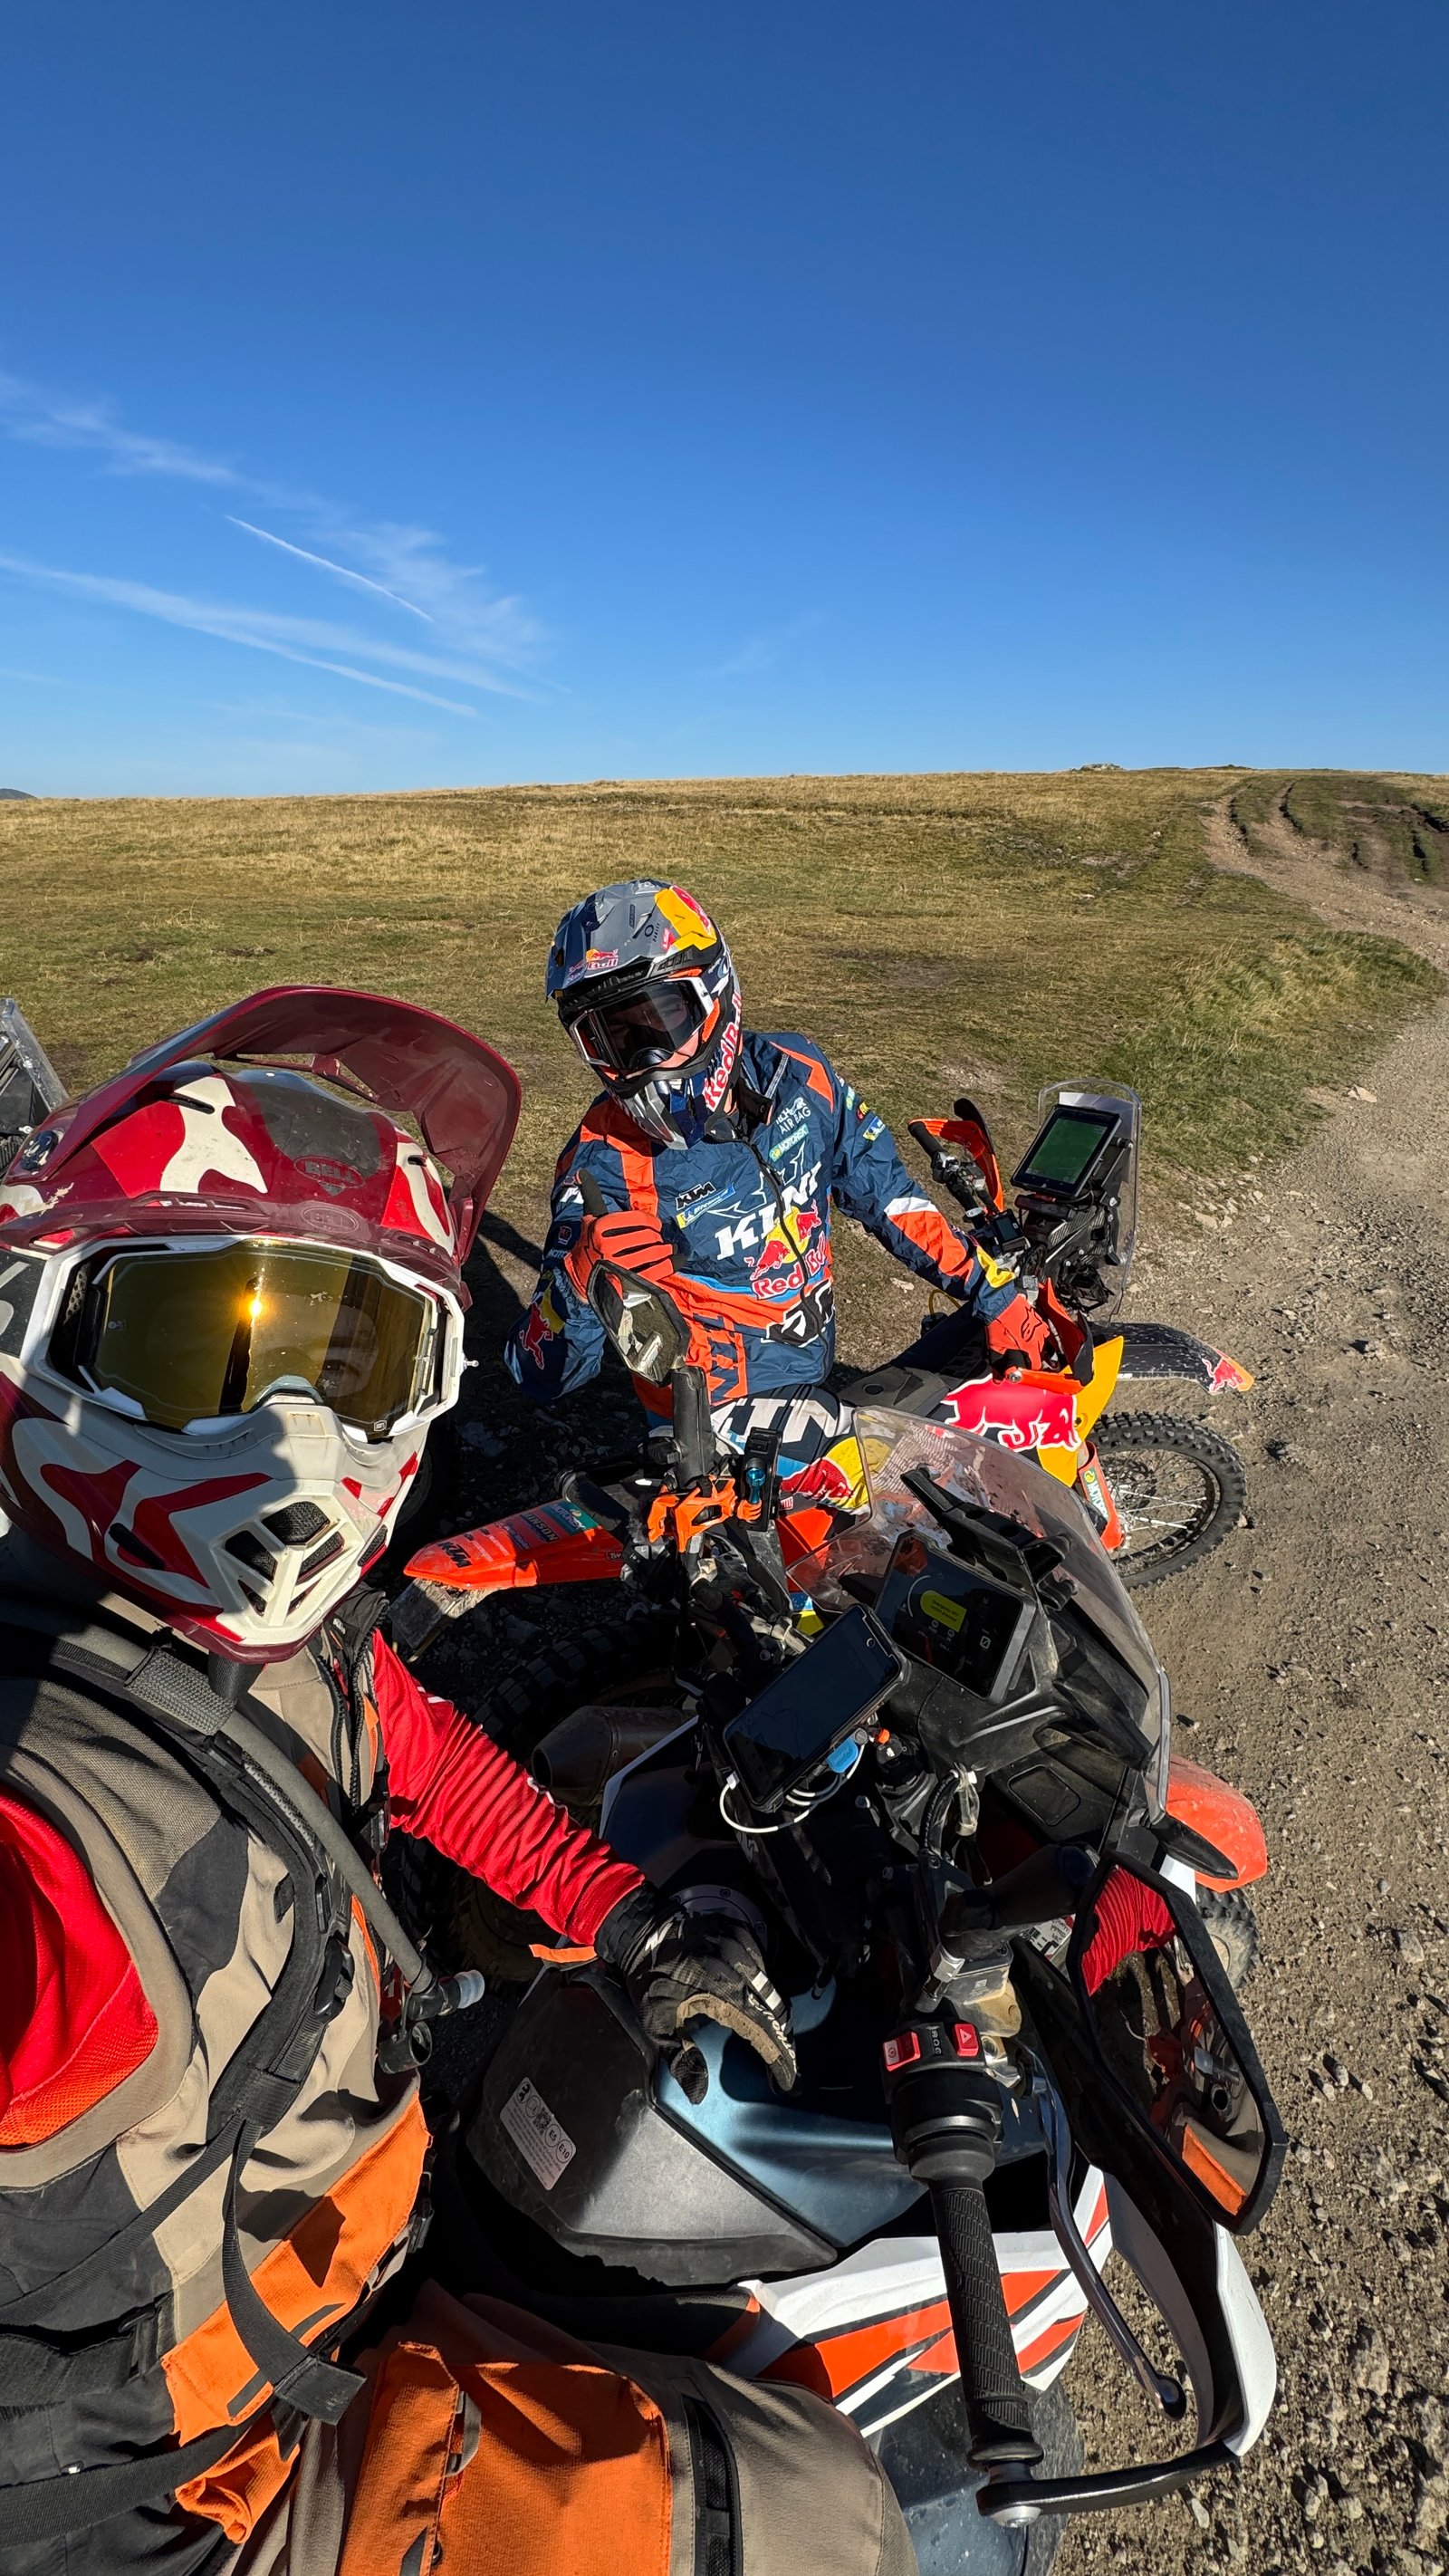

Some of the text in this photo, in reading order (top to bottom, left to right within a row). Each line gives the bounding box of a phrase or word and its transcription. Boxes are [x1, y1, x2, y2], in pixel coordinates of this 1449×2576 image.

[702, 1039, 735, 1112] Red
[304, 1160, 356, 1186] BELL
[677, 1182, 716, 1210] KTM
[752, 1262, 805, 1301] Red
[437, 1542, 473, 1569] KTM
[548, 2129, 570, 2159] E5 E10
